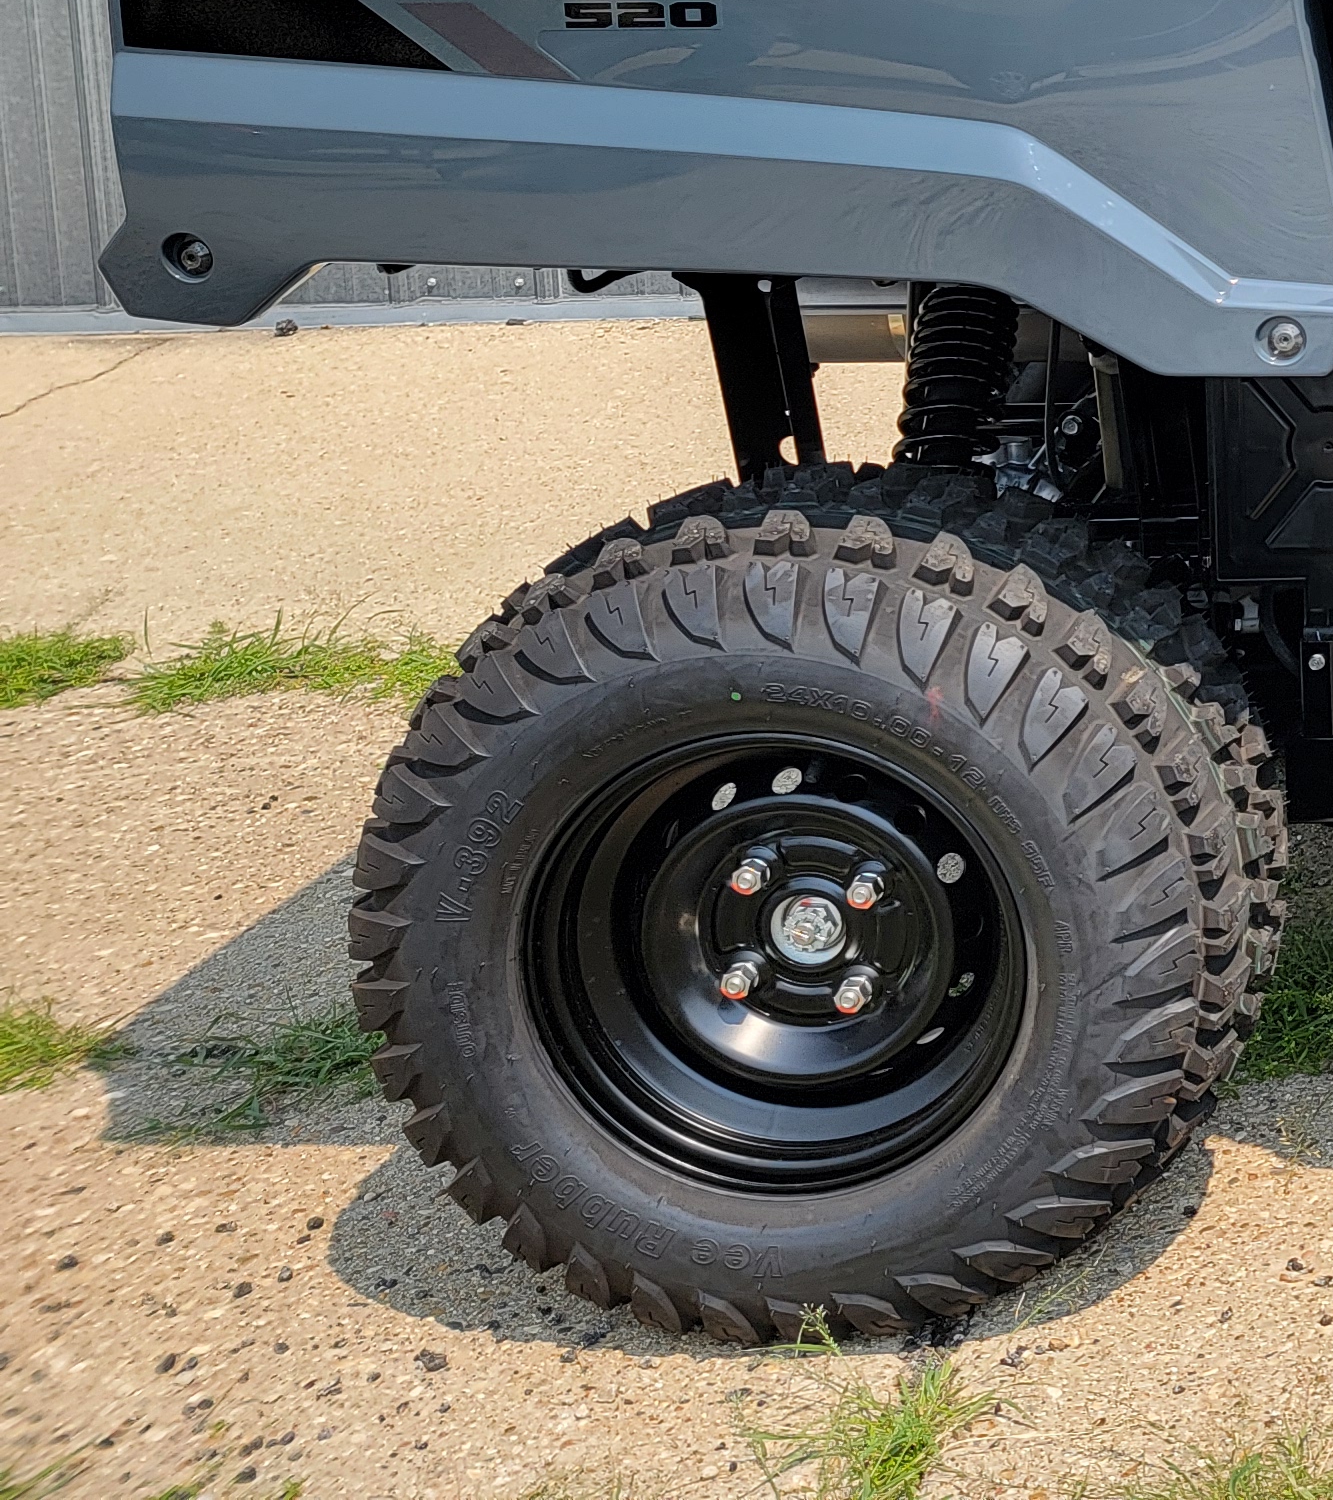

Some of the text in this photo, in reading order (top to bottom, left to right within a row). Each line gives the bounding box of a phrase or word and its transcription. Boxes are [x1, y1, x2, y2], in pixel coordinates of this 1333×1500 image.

[564, 2, 718, 29] 520
[434, 790, 525, 923] V-392
[510, 1140, 785, 1280] Vee Rubber
